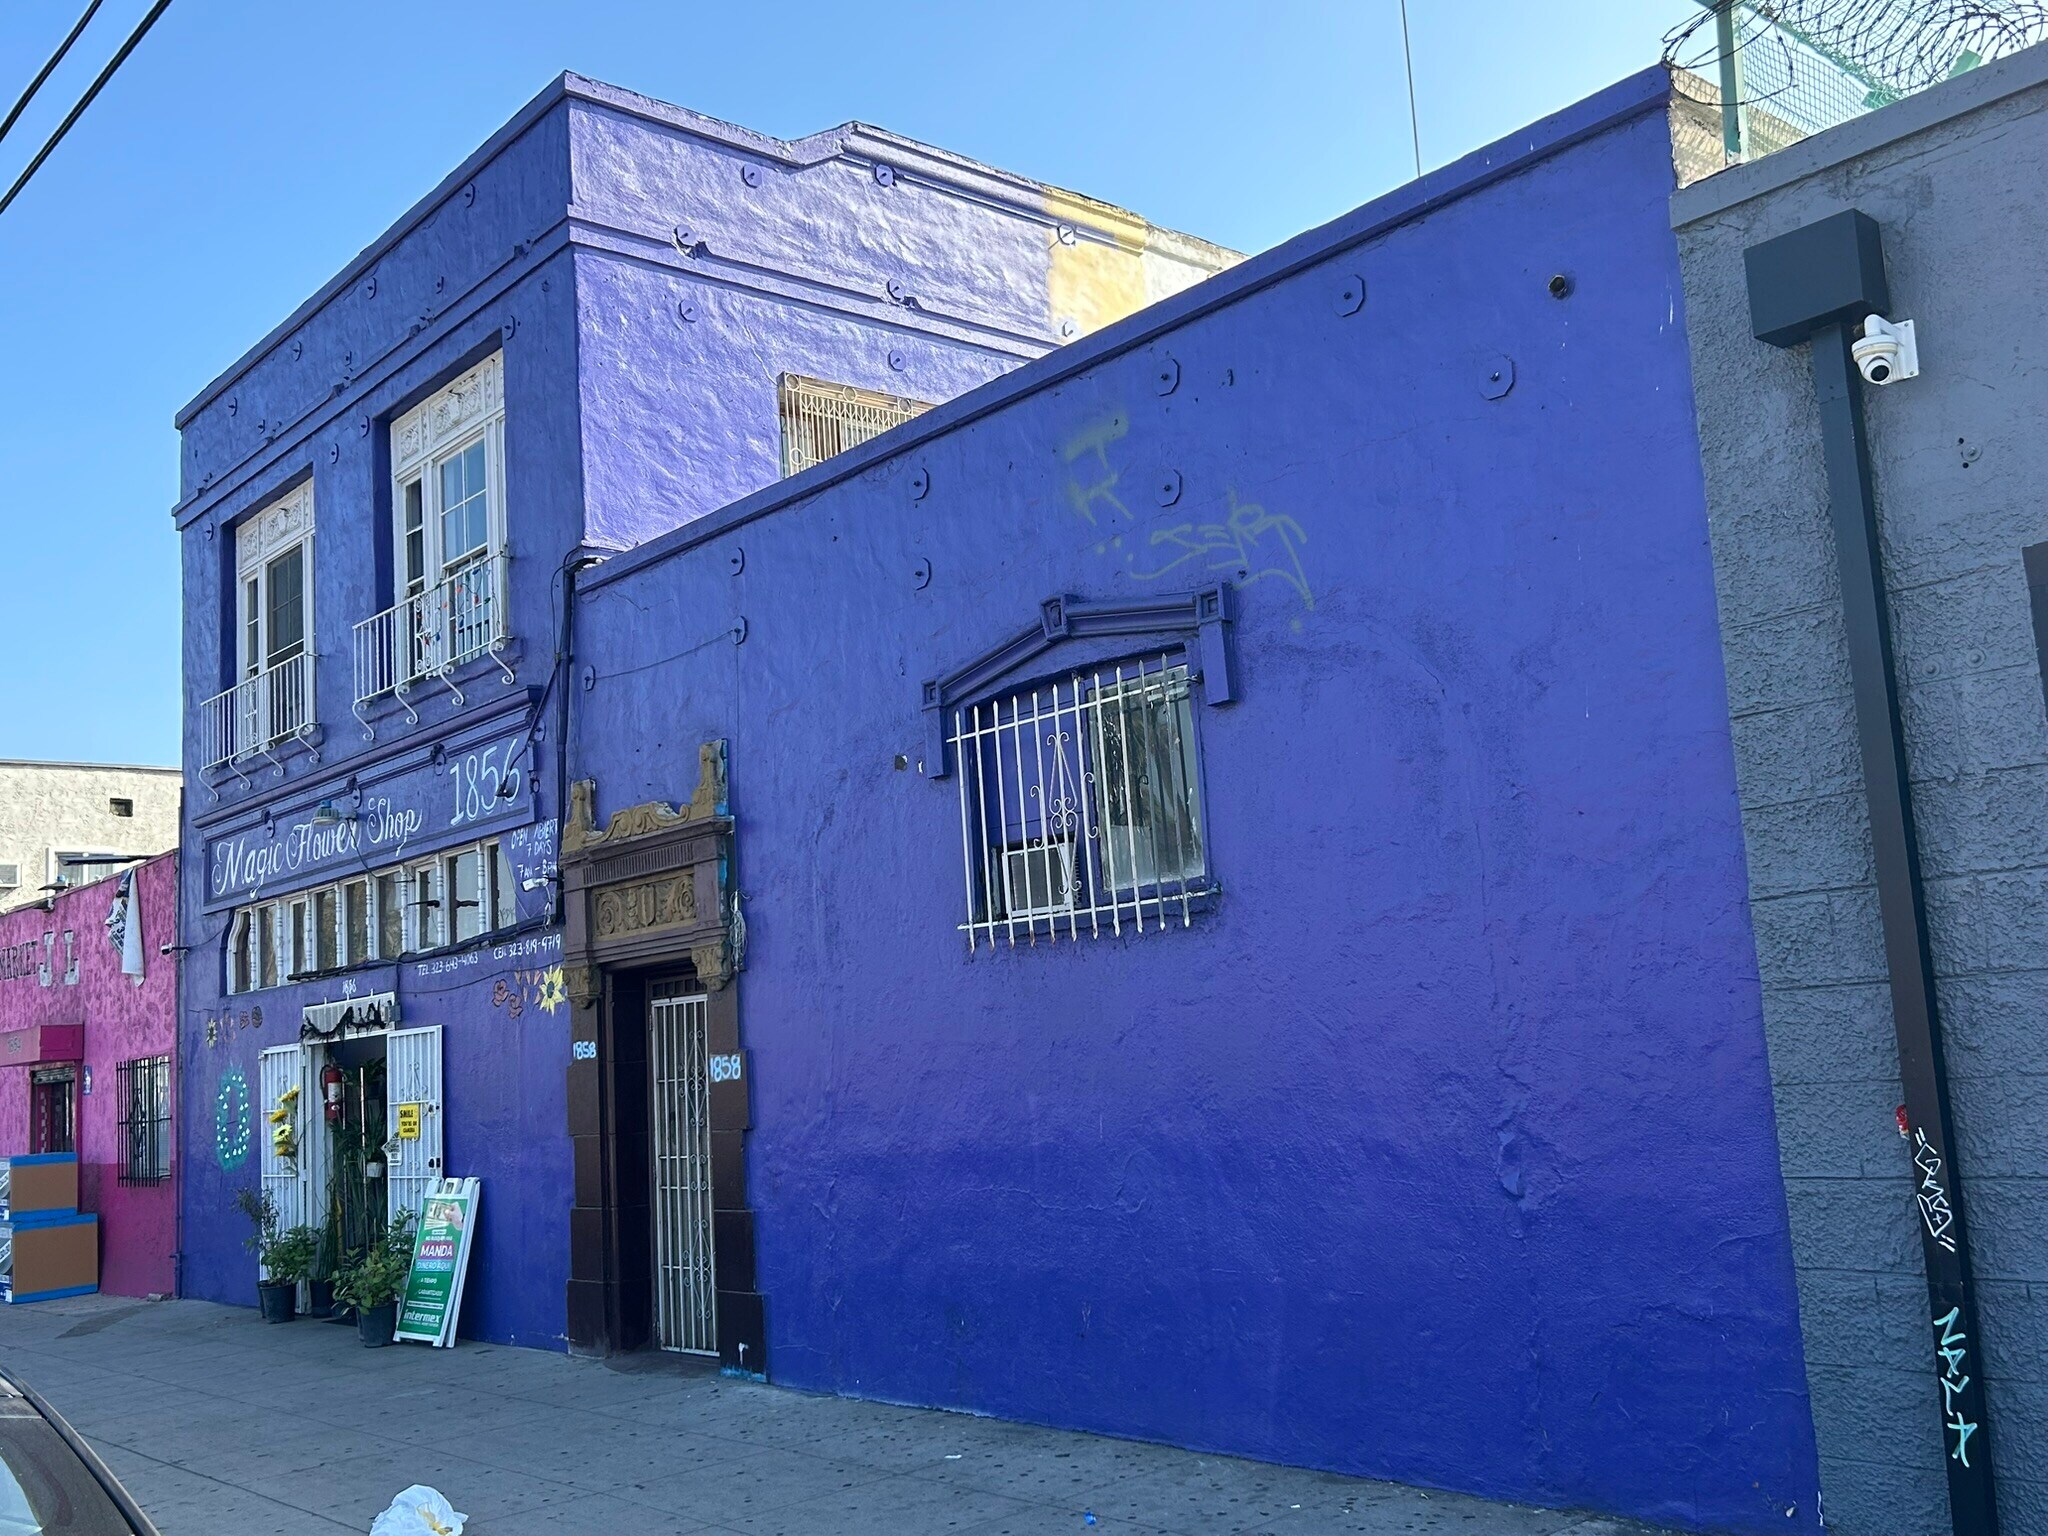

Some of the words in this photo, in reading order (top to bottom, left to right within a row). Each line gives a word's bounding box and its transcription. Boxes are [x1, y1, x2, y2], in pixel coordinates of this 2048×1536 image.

[449, 738, 521, 826] 1856
[211, 837, 285, 899] Magic
[286, 821, 362, 870] Flower
[366, 797, 423, 857] Shop
[511, 827, 529, 850] OPEN
[526, 843, 532, 857] 7
[534, 839, 552, 855] DAYS
[572, 1040, 597, 1060] 1858
[709, 1053, 742, 1082] 1858
[420, 1244, 454, 1257] MANDA
[403, 1309, 442, 1324] intermex
